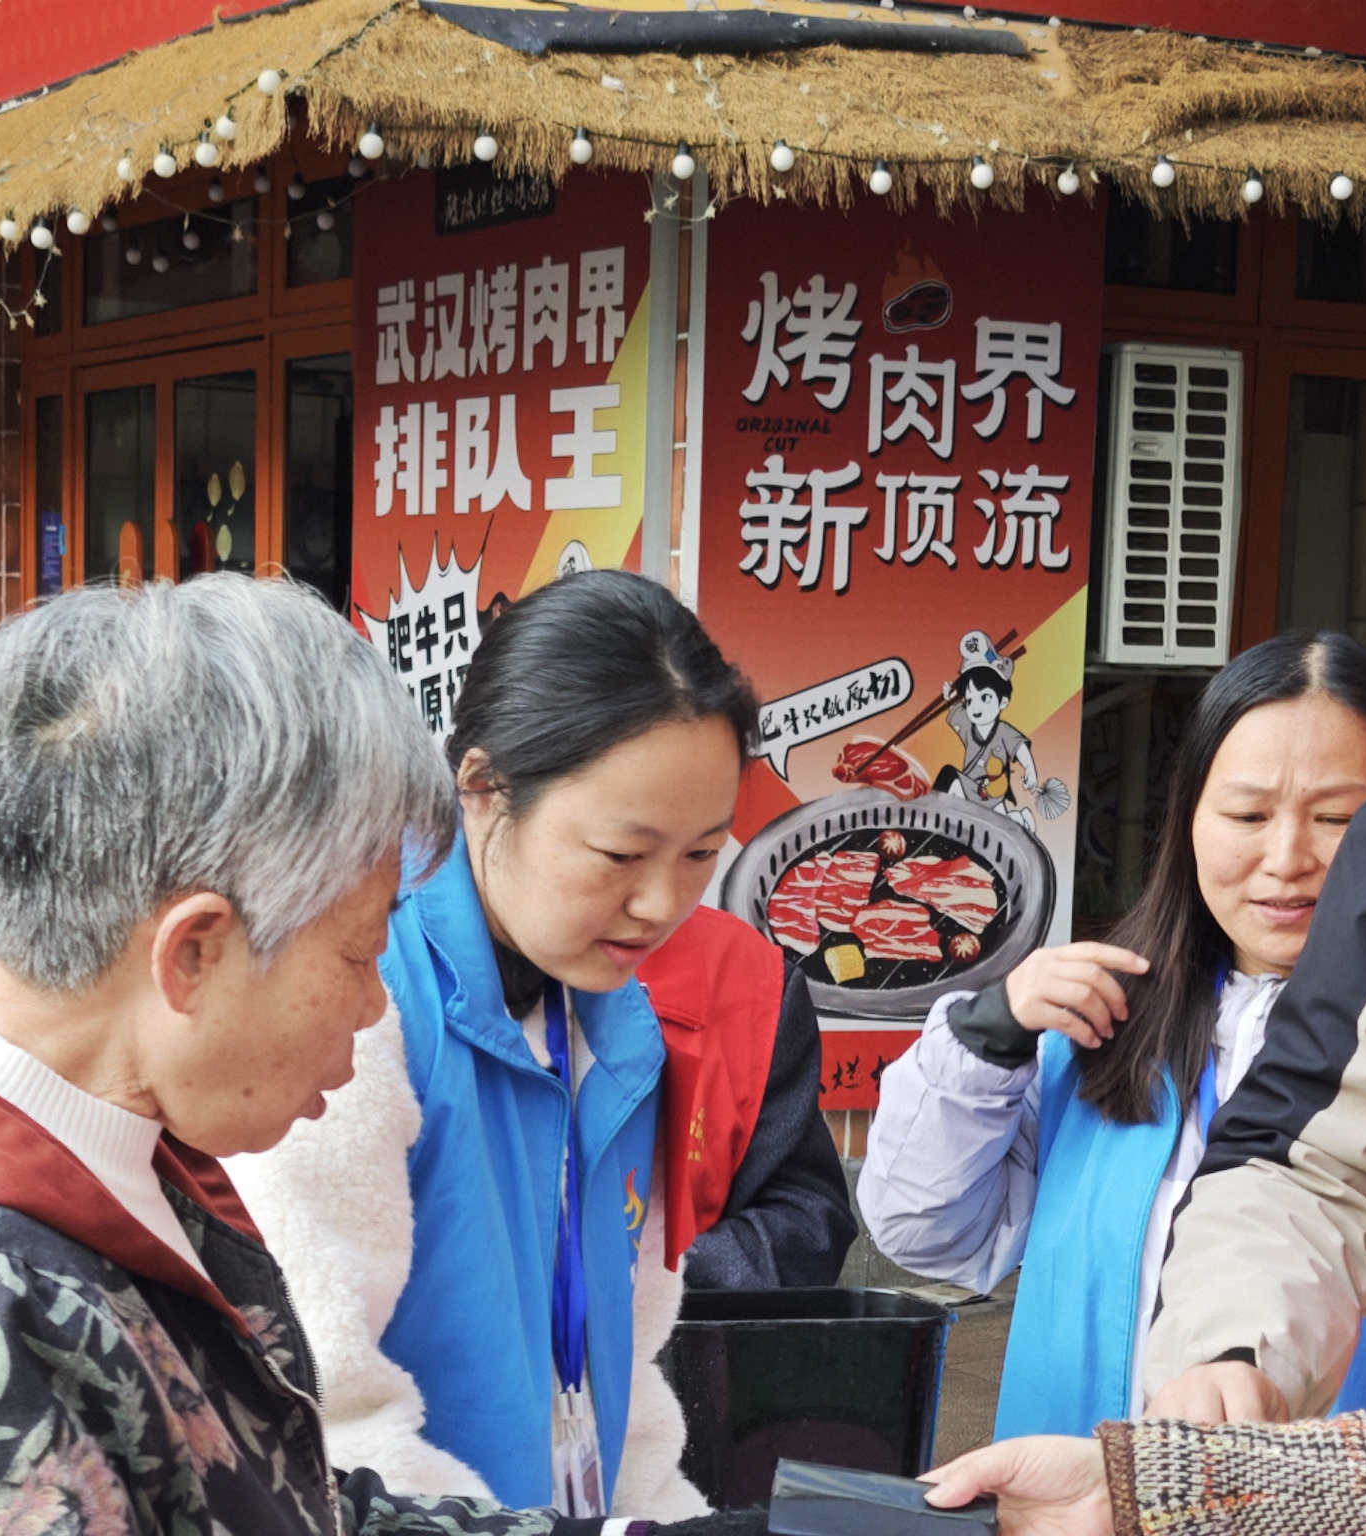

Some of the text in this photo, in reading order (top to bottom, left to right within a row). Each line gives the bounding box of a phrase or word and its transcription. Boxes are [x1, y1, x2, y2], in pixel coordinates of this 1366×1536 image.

[376, 246, 625, 385] 武汉烤肉界
[740, 271, 1076, 460] 烤肉界
[374, 383, 622, 517] 排队王
[763, 436, 801, 453] CUT
[738, 454, 1072, 592] 新顶流
[387, 592, 469, 673] 肥牛只
